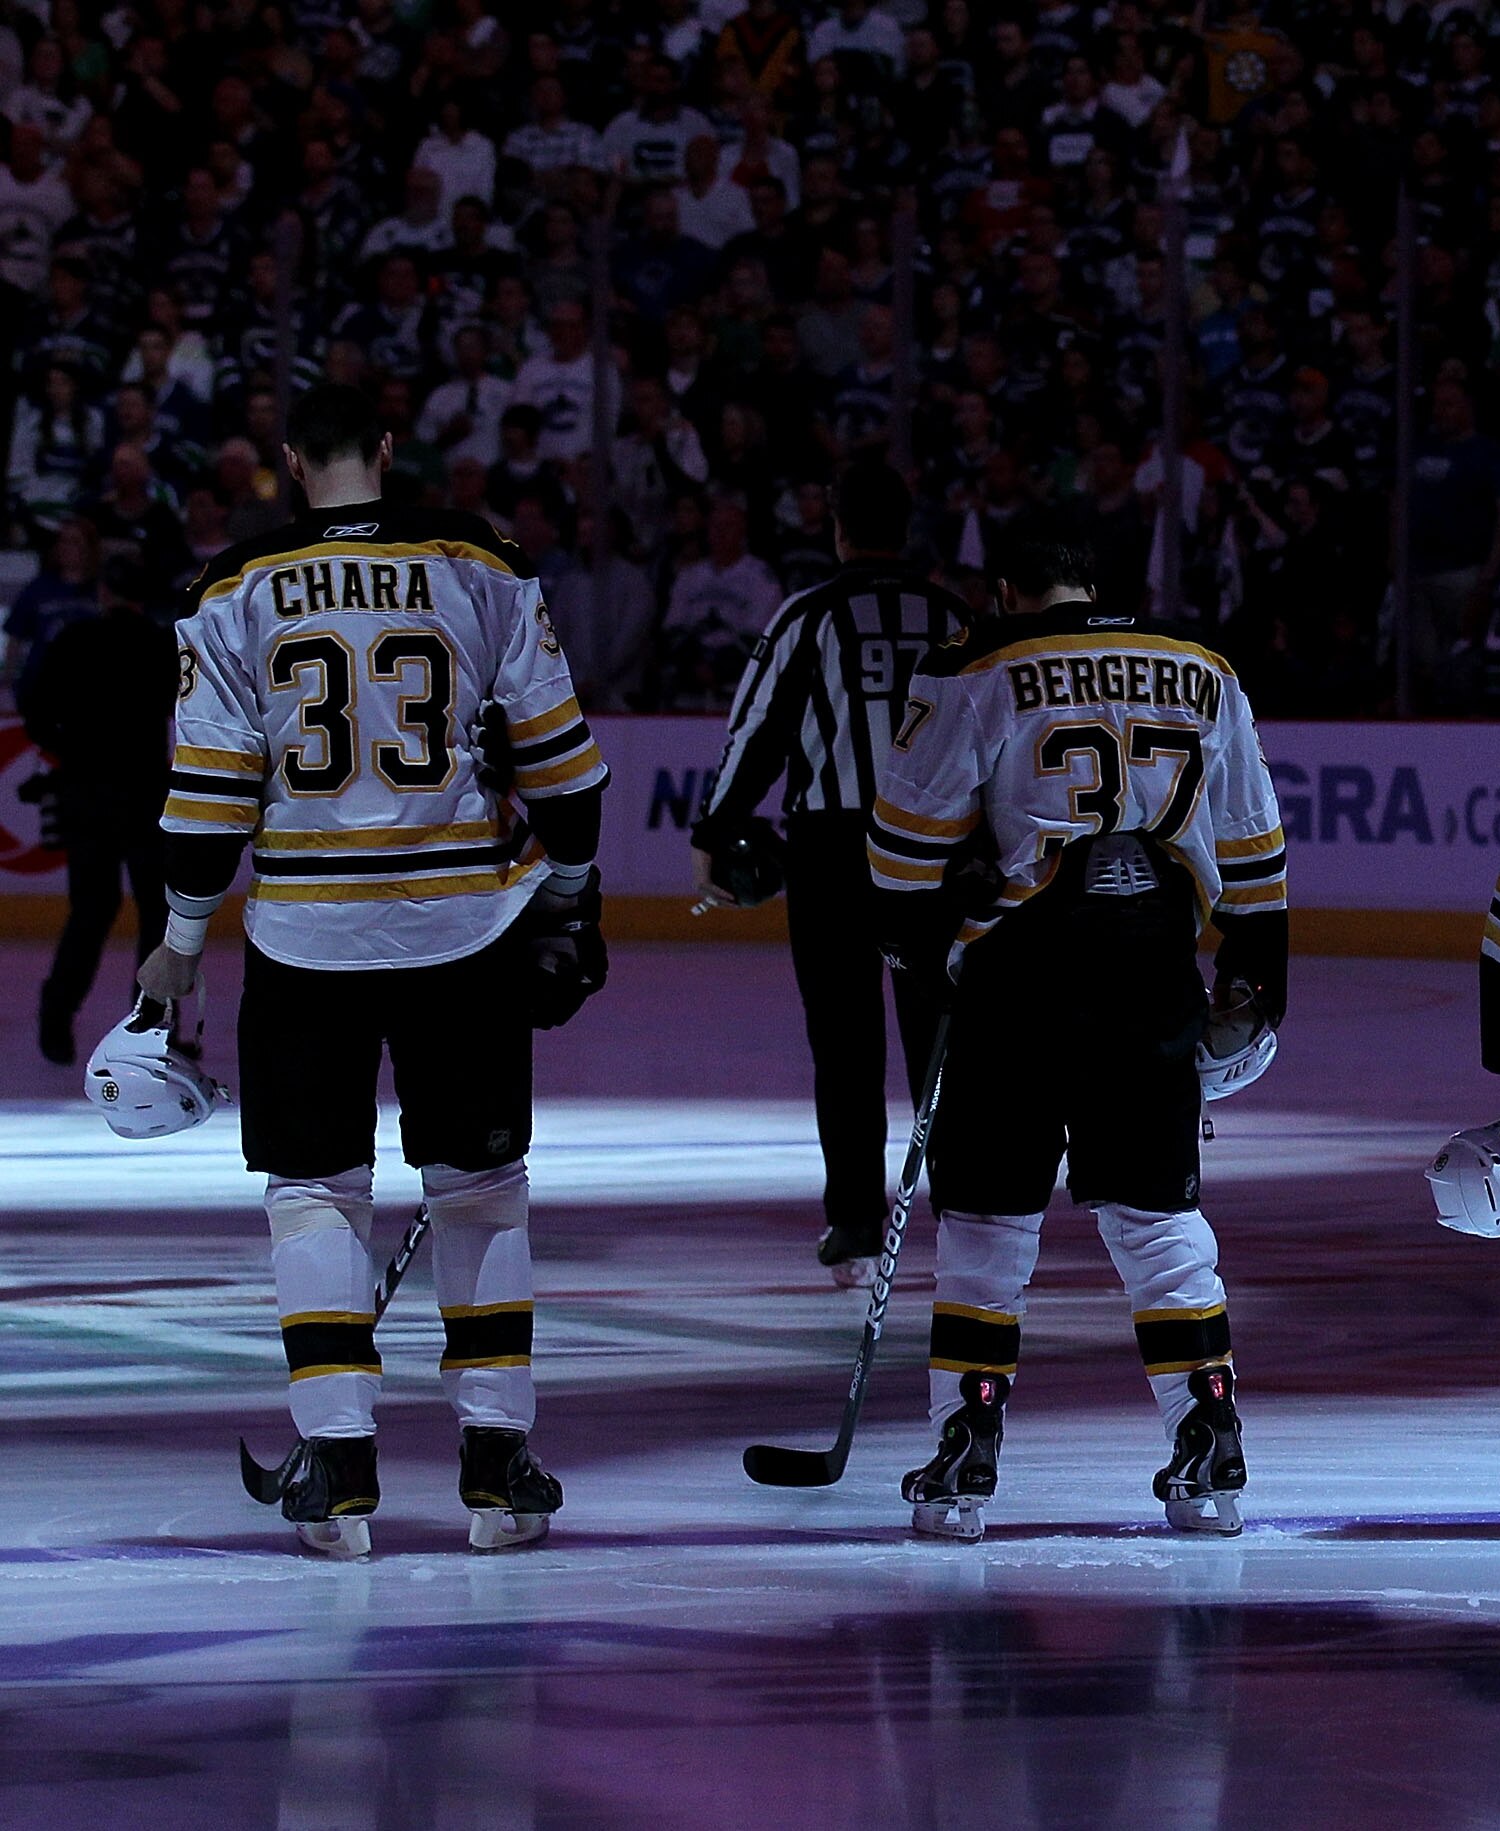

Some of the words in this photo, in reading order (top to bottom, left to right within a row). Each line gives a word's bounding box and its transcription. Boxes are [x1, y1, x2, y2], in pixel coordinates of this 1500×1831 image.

[271, 562, 434, 619] CHARA
[860, 639, 930, 693] 97
[1007, 655, 1227, 723] BERGERON
[266, 630, 463, 798] 33
[1034, 718, 1206, 862] 37
